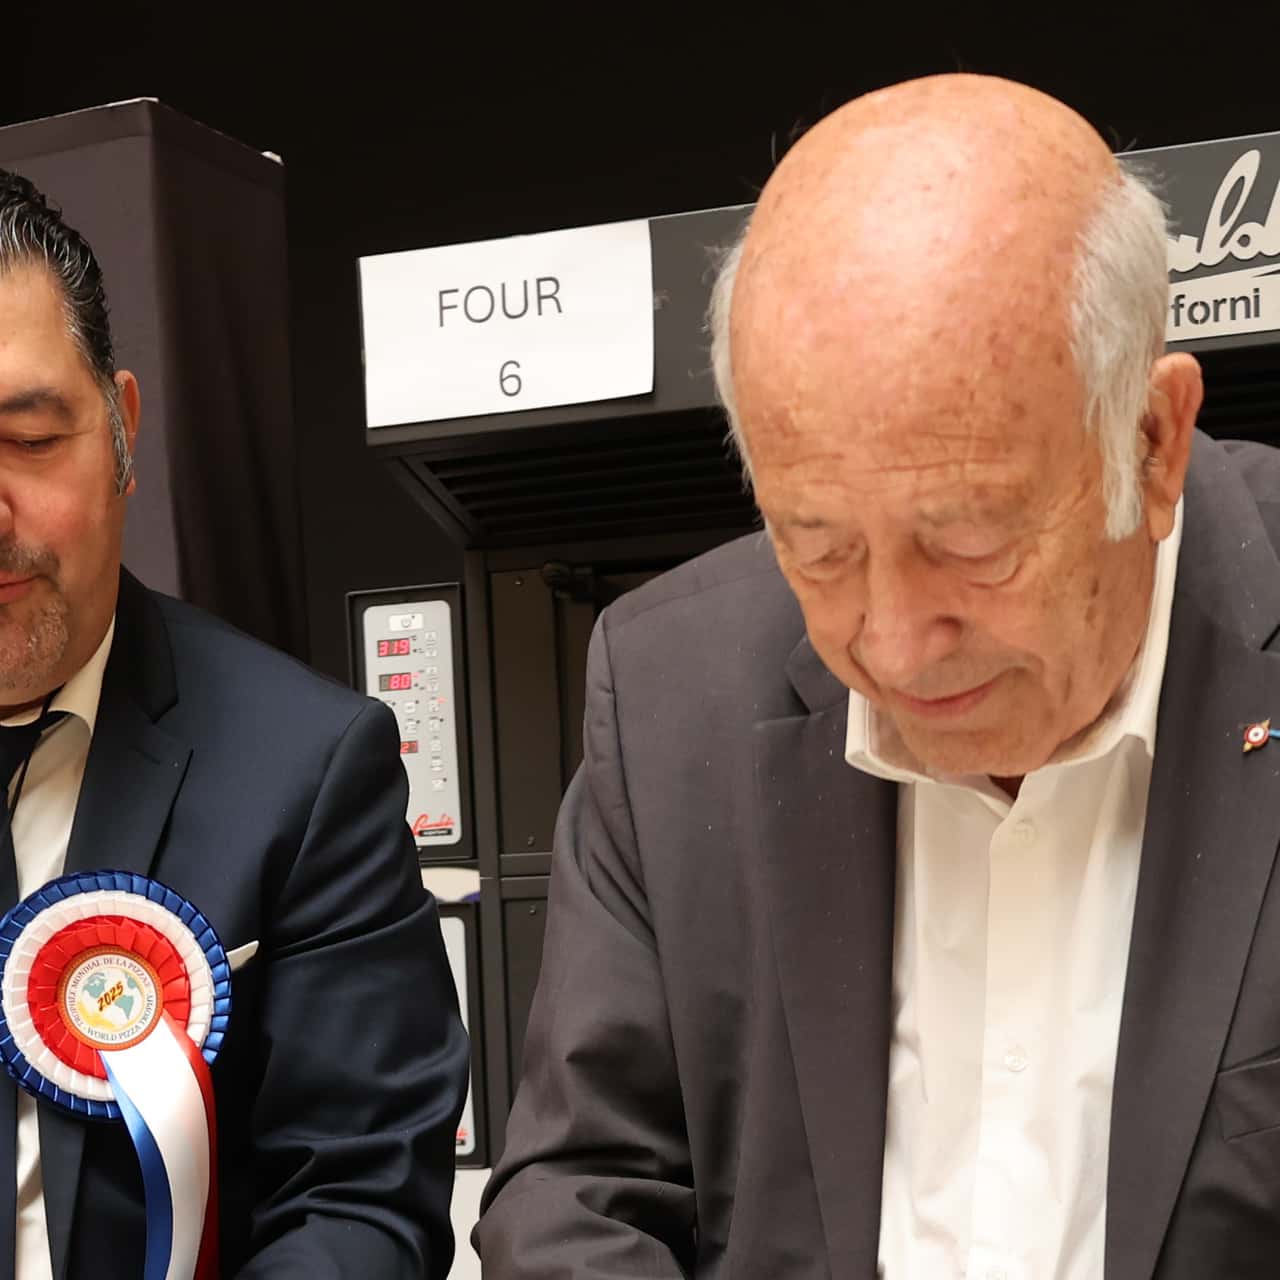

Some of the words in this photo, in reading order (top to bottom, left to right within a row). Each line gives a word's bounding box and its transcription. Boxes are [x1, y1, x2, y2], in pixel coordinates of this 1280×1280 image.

[437, 275, 563, 328] FOUR
[498, 360, 522, 397] 6
[97, 981, 124, 1012] 2025
